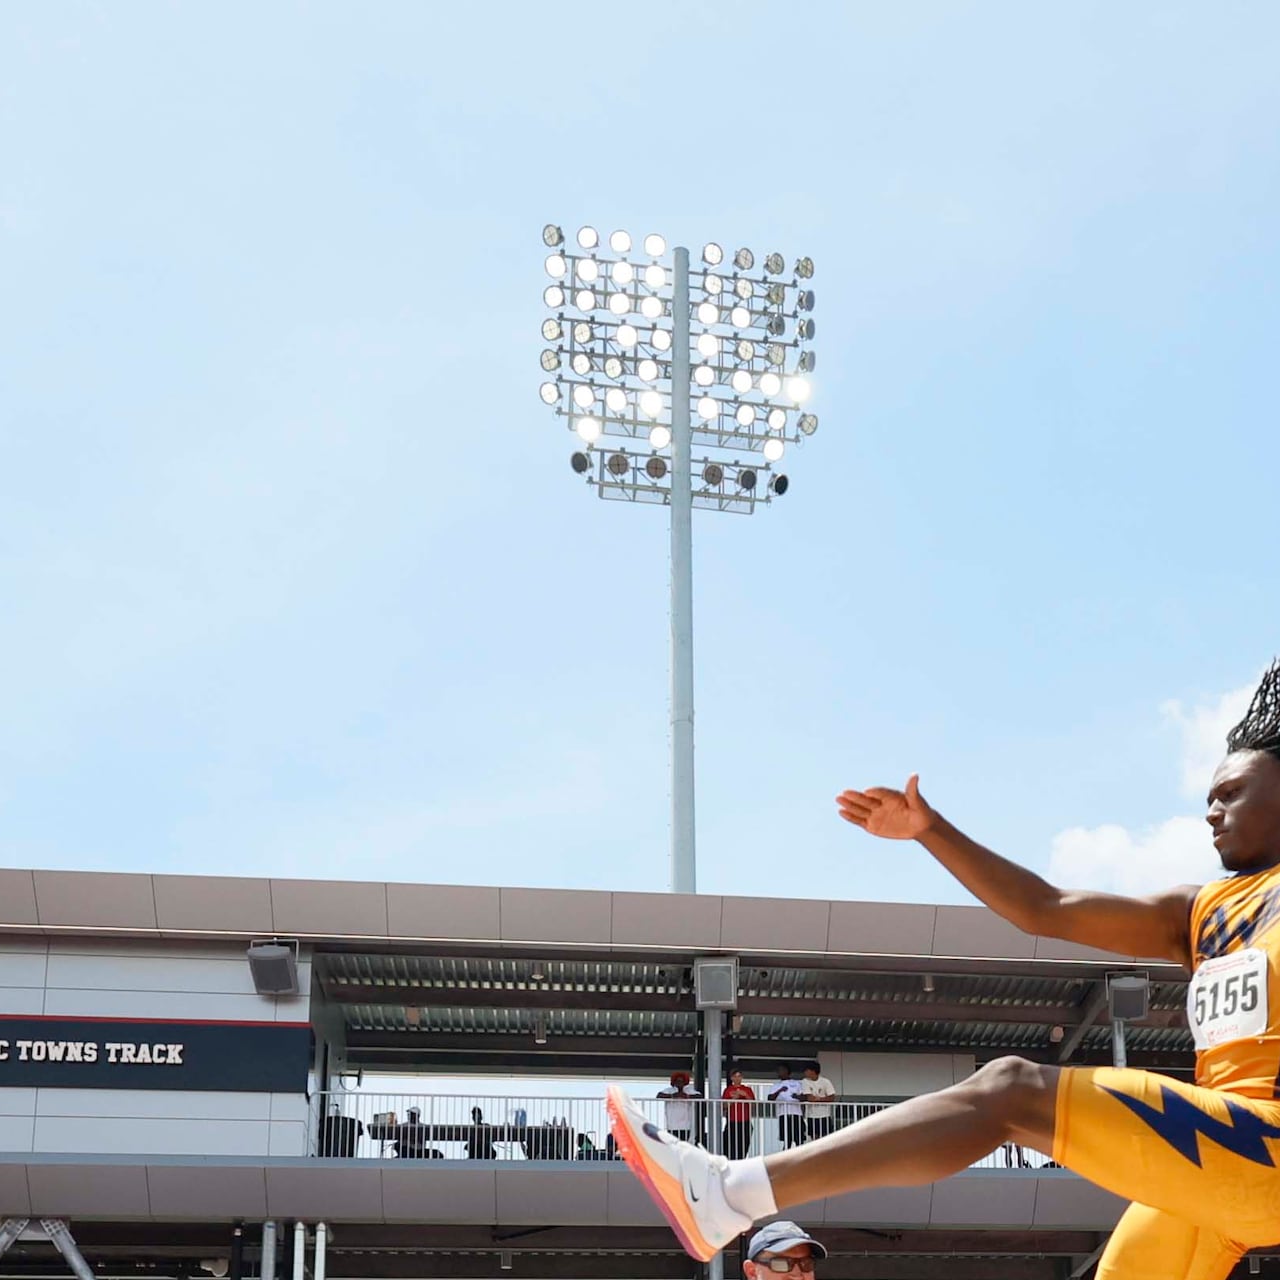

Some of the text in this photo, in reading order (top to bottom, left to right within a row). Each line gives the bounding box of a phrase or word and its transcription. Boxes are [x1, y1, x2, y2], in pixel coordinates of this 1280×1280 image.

[1195, 970, 1259, 1026] 5155
[16, 1041, 98, 1062] TOWNS
[105, 1043, 184, 1064] TRACK
